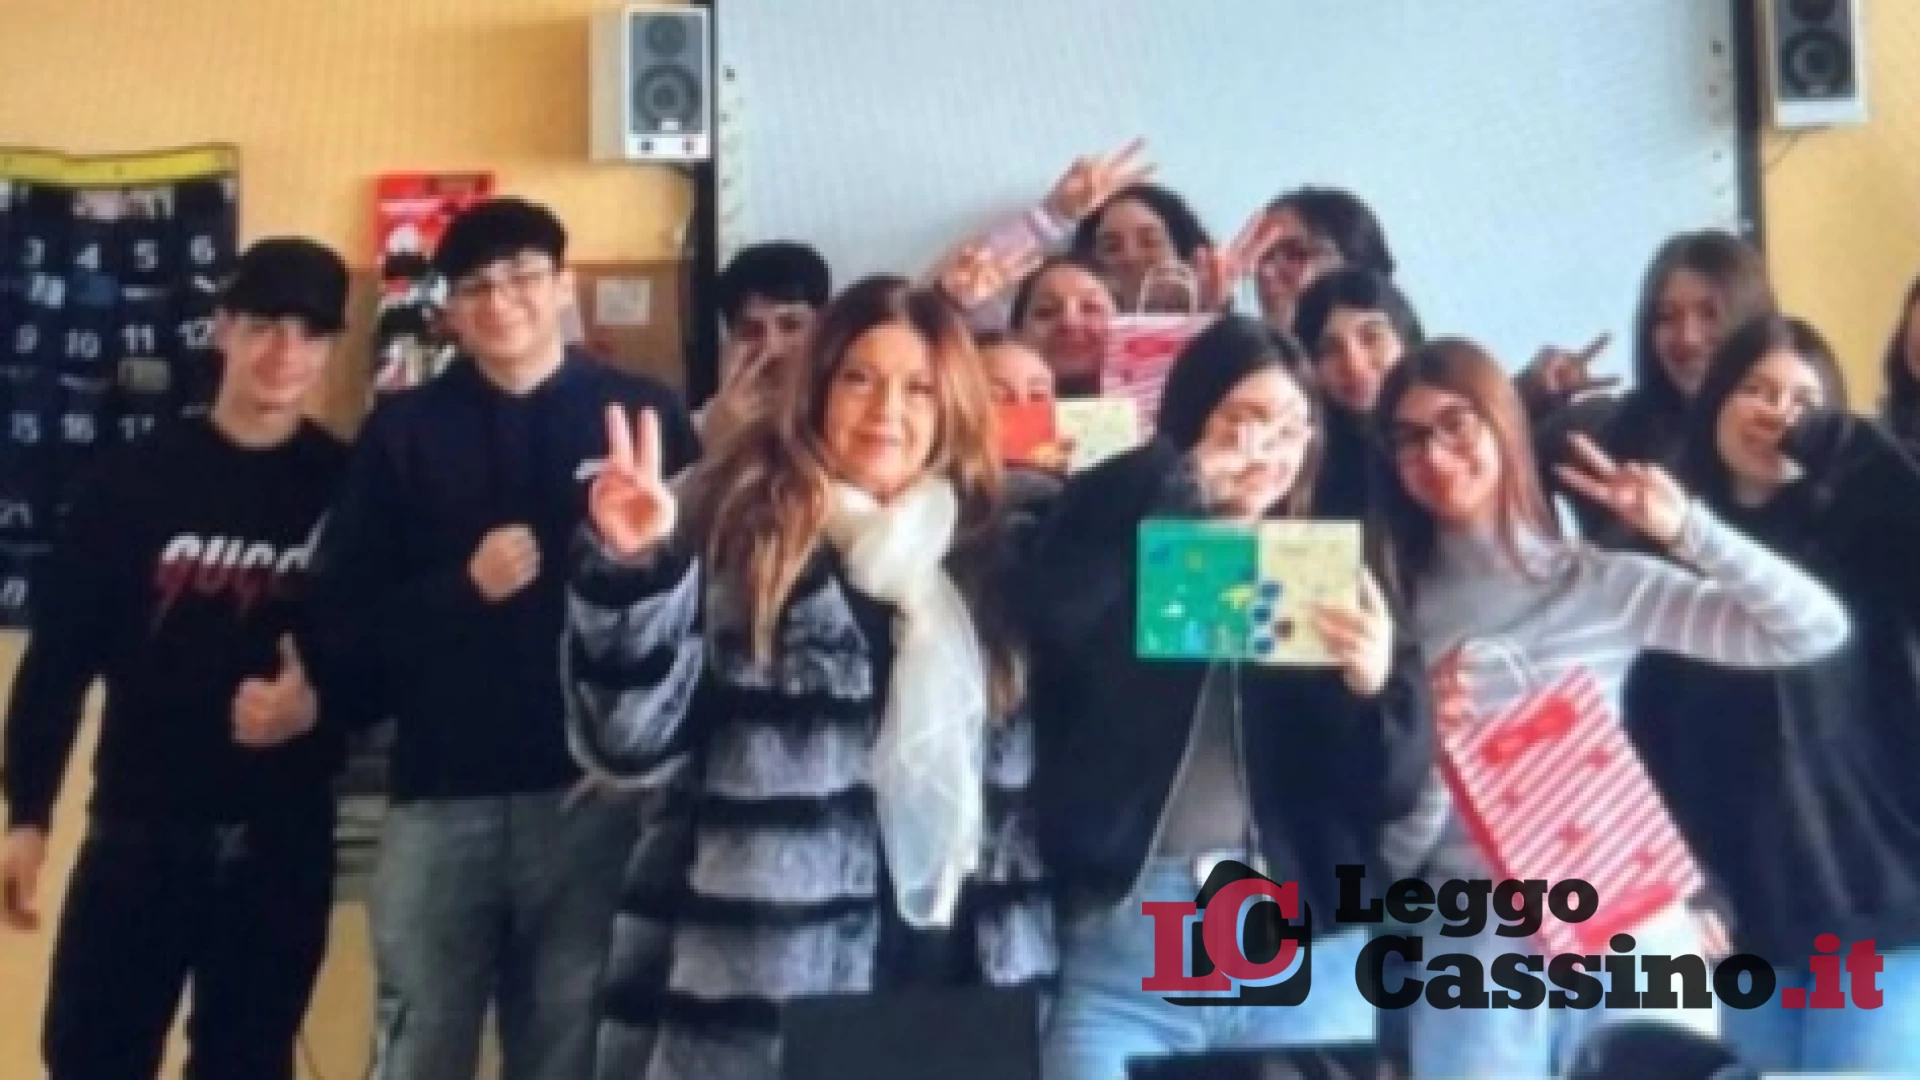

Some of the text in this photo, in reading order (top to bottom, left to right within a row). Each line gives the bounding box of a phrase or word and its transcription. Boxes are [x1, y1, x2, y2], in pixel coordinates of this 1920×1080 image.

[24, 235, 215, 271] 3 4 5 6
[16, 325, 39, 353] 9
[65, 329, 100, 359] 10
[121, 324, 156, 354] 11
[62, 411, 96, 442] 16
